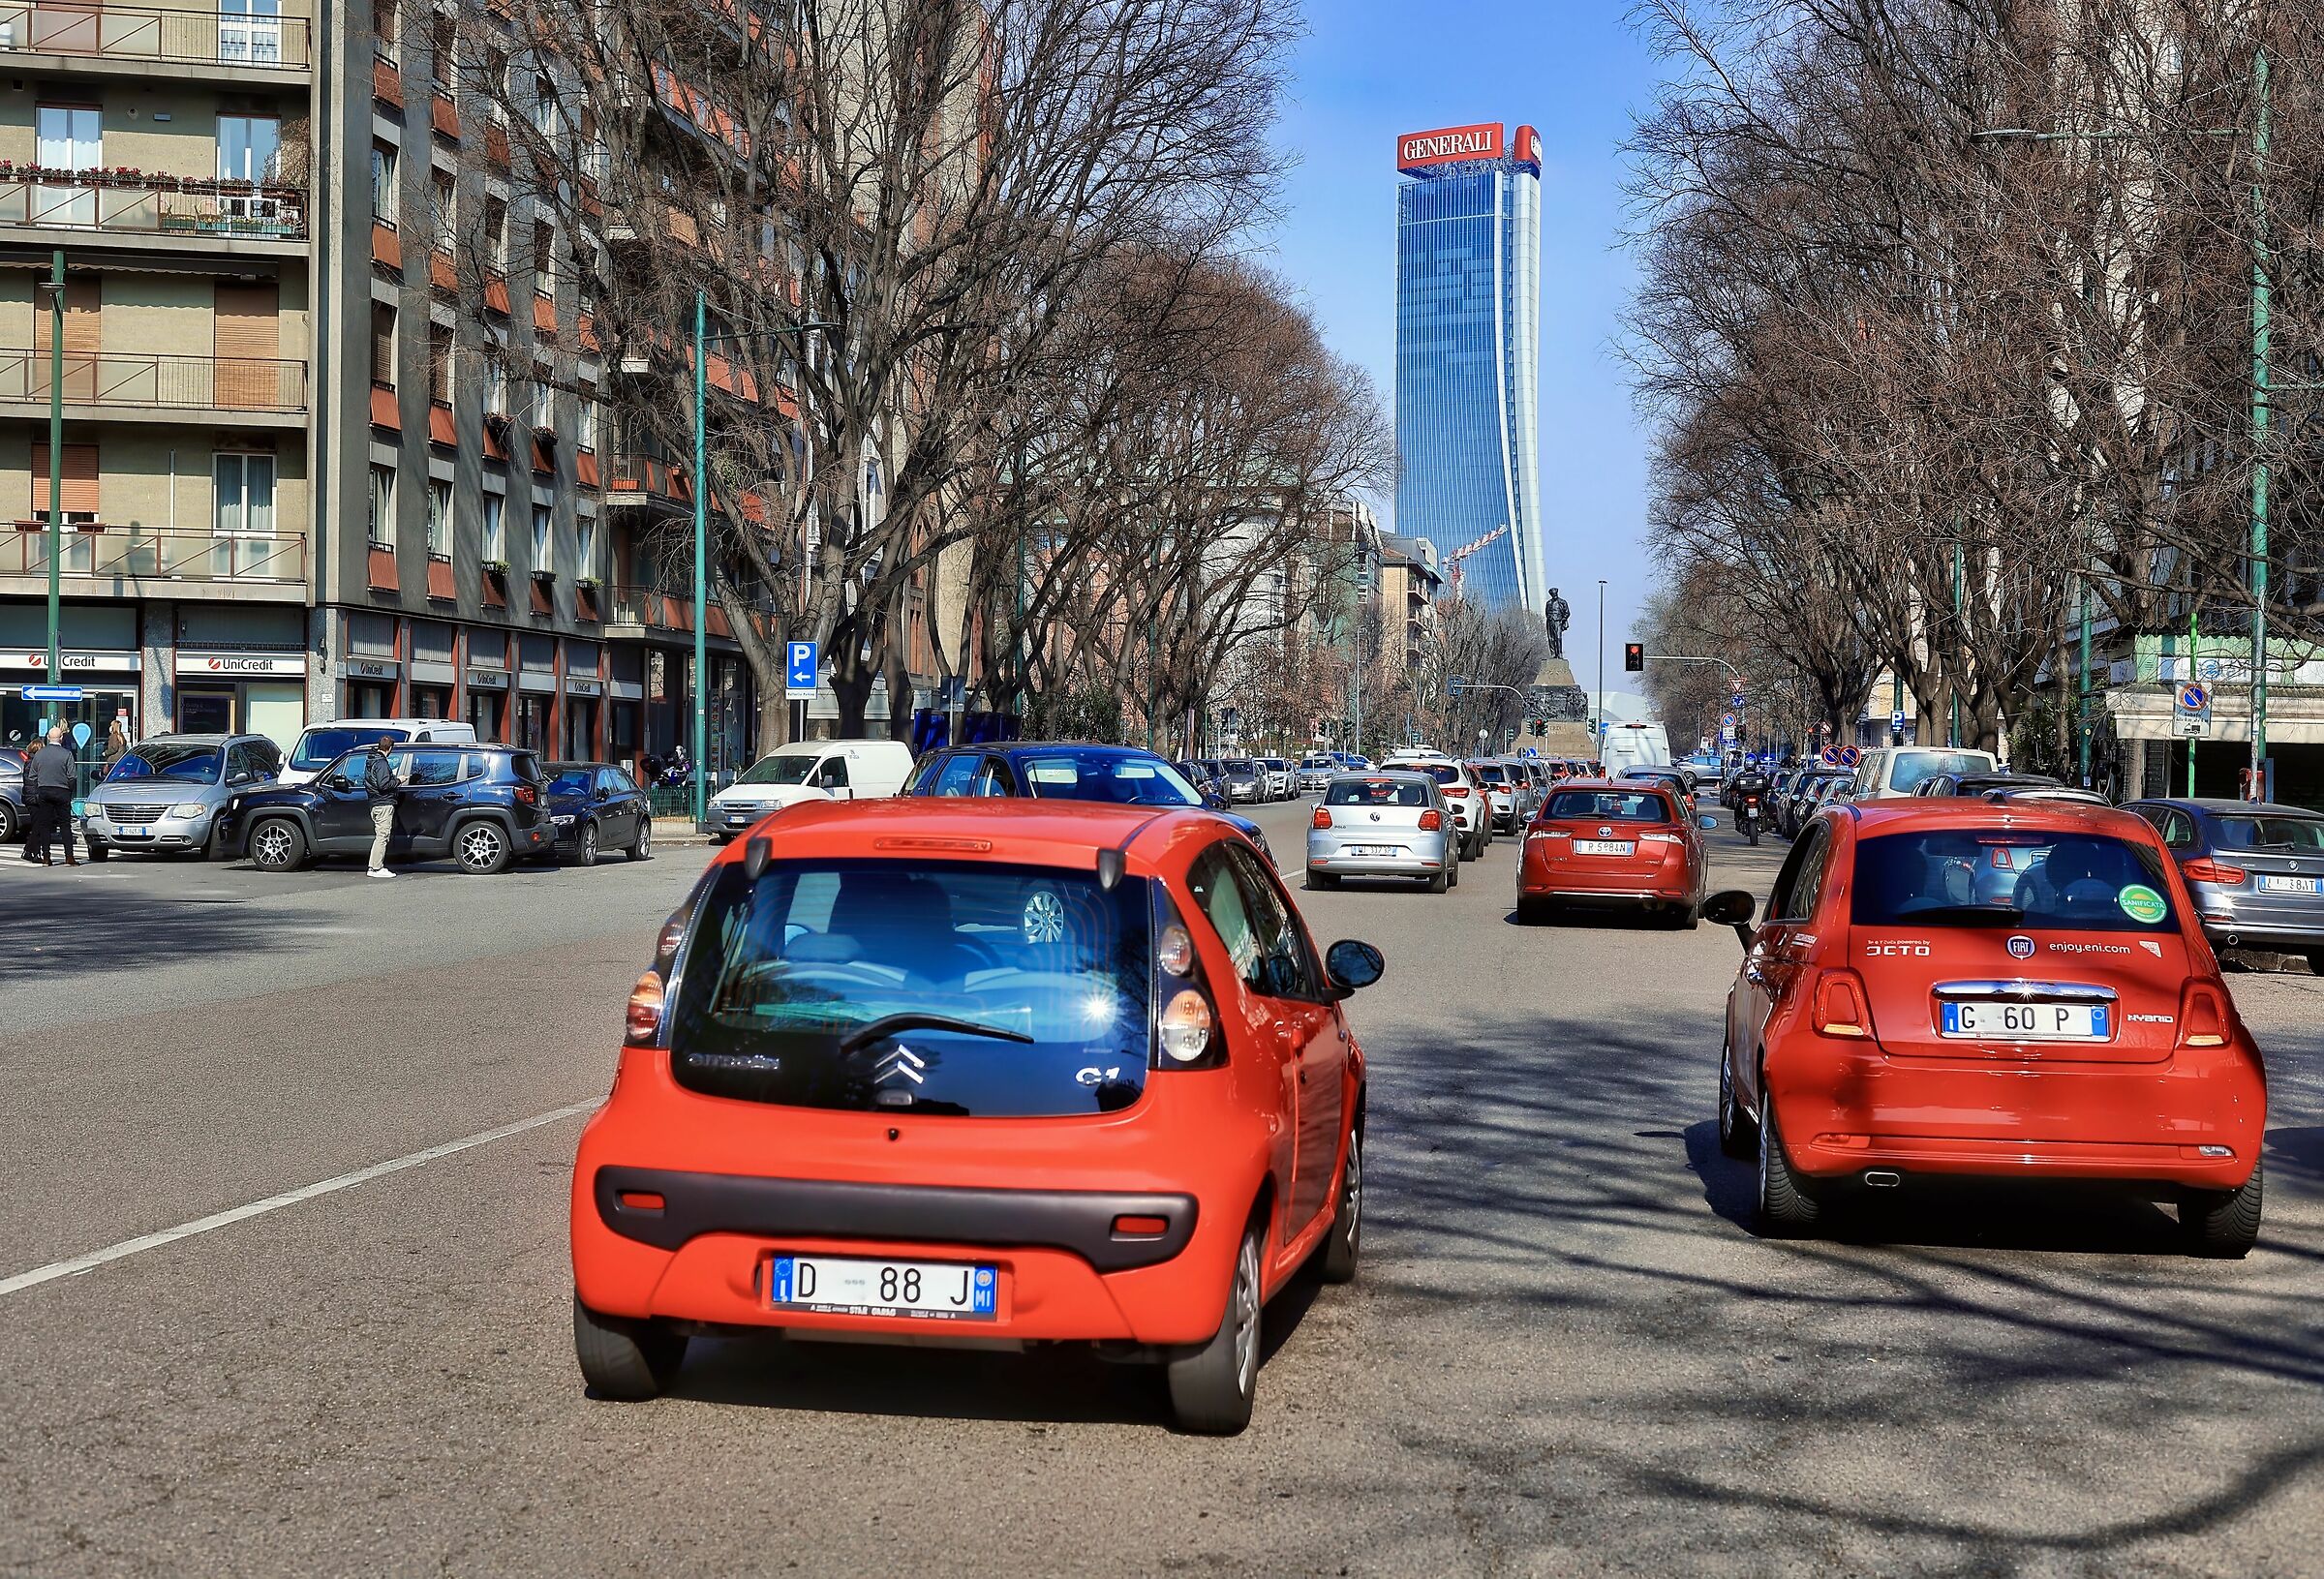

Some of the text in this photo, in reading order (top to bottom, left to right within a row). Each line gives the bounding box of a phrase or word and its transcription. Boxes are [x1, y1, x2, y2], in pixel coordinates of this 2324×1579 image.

[1403, 131, 1493, 161] GENERALI
[44, 655, 96, 667] UCredit
[794, 645, 810, 667] P
[223, 658, 273, 671] UniCredit
[1891, 712, 1903, 726] P
[2122, 899, 2165, 909] SANIFICATA
[2012, 941, 2030, 954] FIAT
[2049, 942, 2130, 955] enjoy.eni.com
[2126, 1014, 2174, 1023] HYBRID
[1075, 1067, 1120, 1086] C1
[880, 1266, 921, 1303] 88
